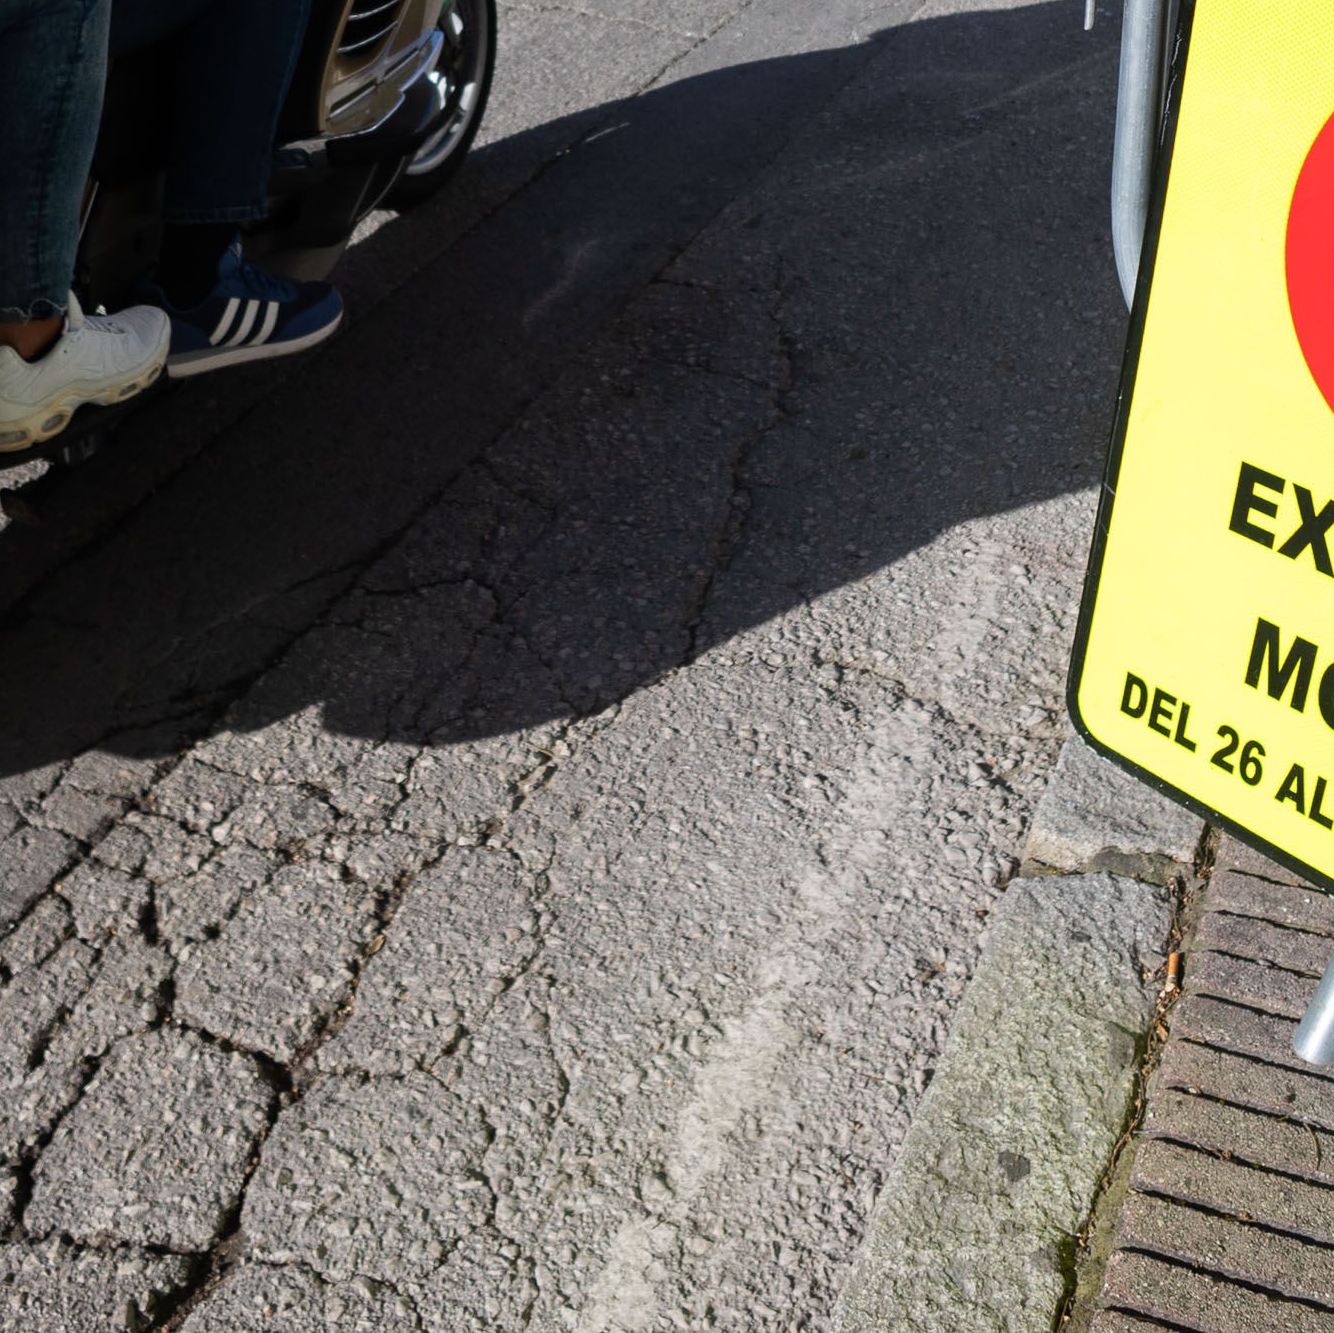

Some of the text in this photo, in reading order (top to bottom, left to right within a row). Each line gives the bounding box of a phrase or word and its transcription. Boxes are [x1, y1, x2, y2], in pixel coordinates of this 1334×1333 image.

[1120, 672, 1196, 752] DEL
[1210, 725, 1266, 786] 26
[1274, 763, 1333, 830] AL
